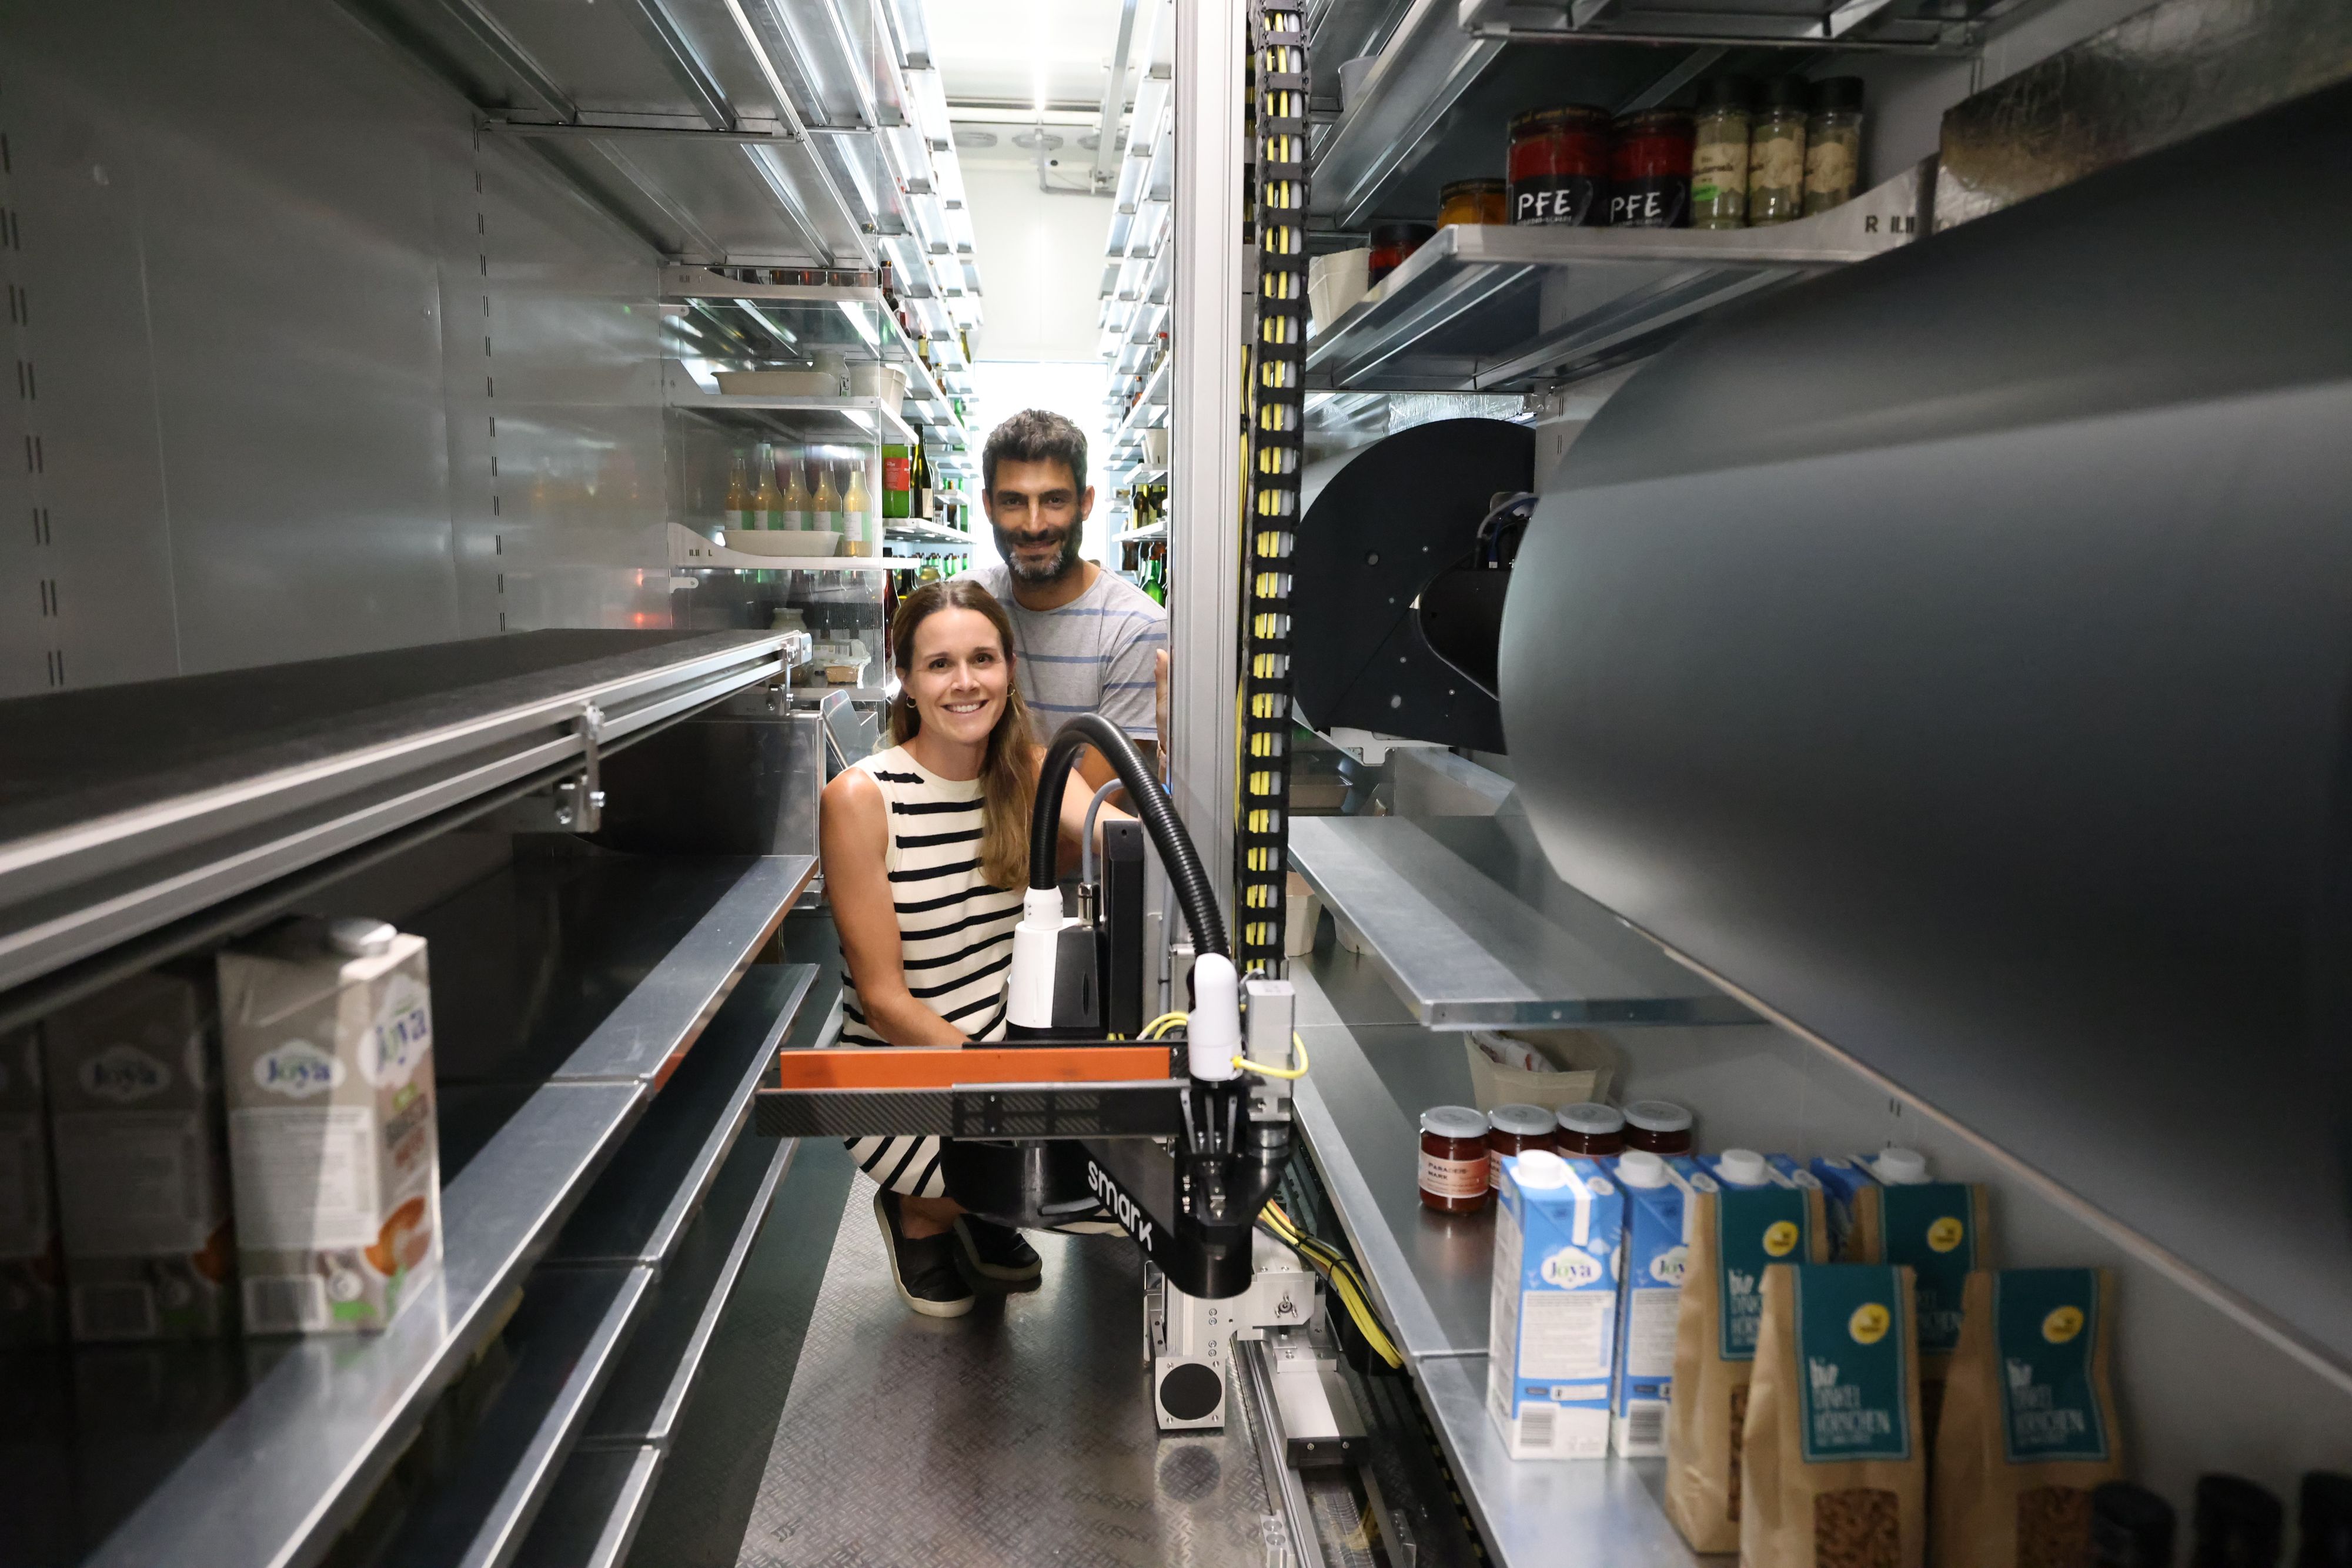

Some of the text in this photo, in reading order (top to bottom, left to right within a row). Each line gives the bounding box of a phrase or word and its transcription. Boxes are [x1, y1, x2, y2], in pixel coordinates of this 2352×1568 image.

[1518, 189, 1571, 220] PFE
[1610, 192, 1661, 223] PFE
[1865, 215, 1878, 232] R
[268, 1058, 331, 1091] Joya
[1088, 1160, 1152, 1252] smark
[1550, 1261, 1592, 1283] Joya
[1659, 1259, 1685, 1281] Joy
